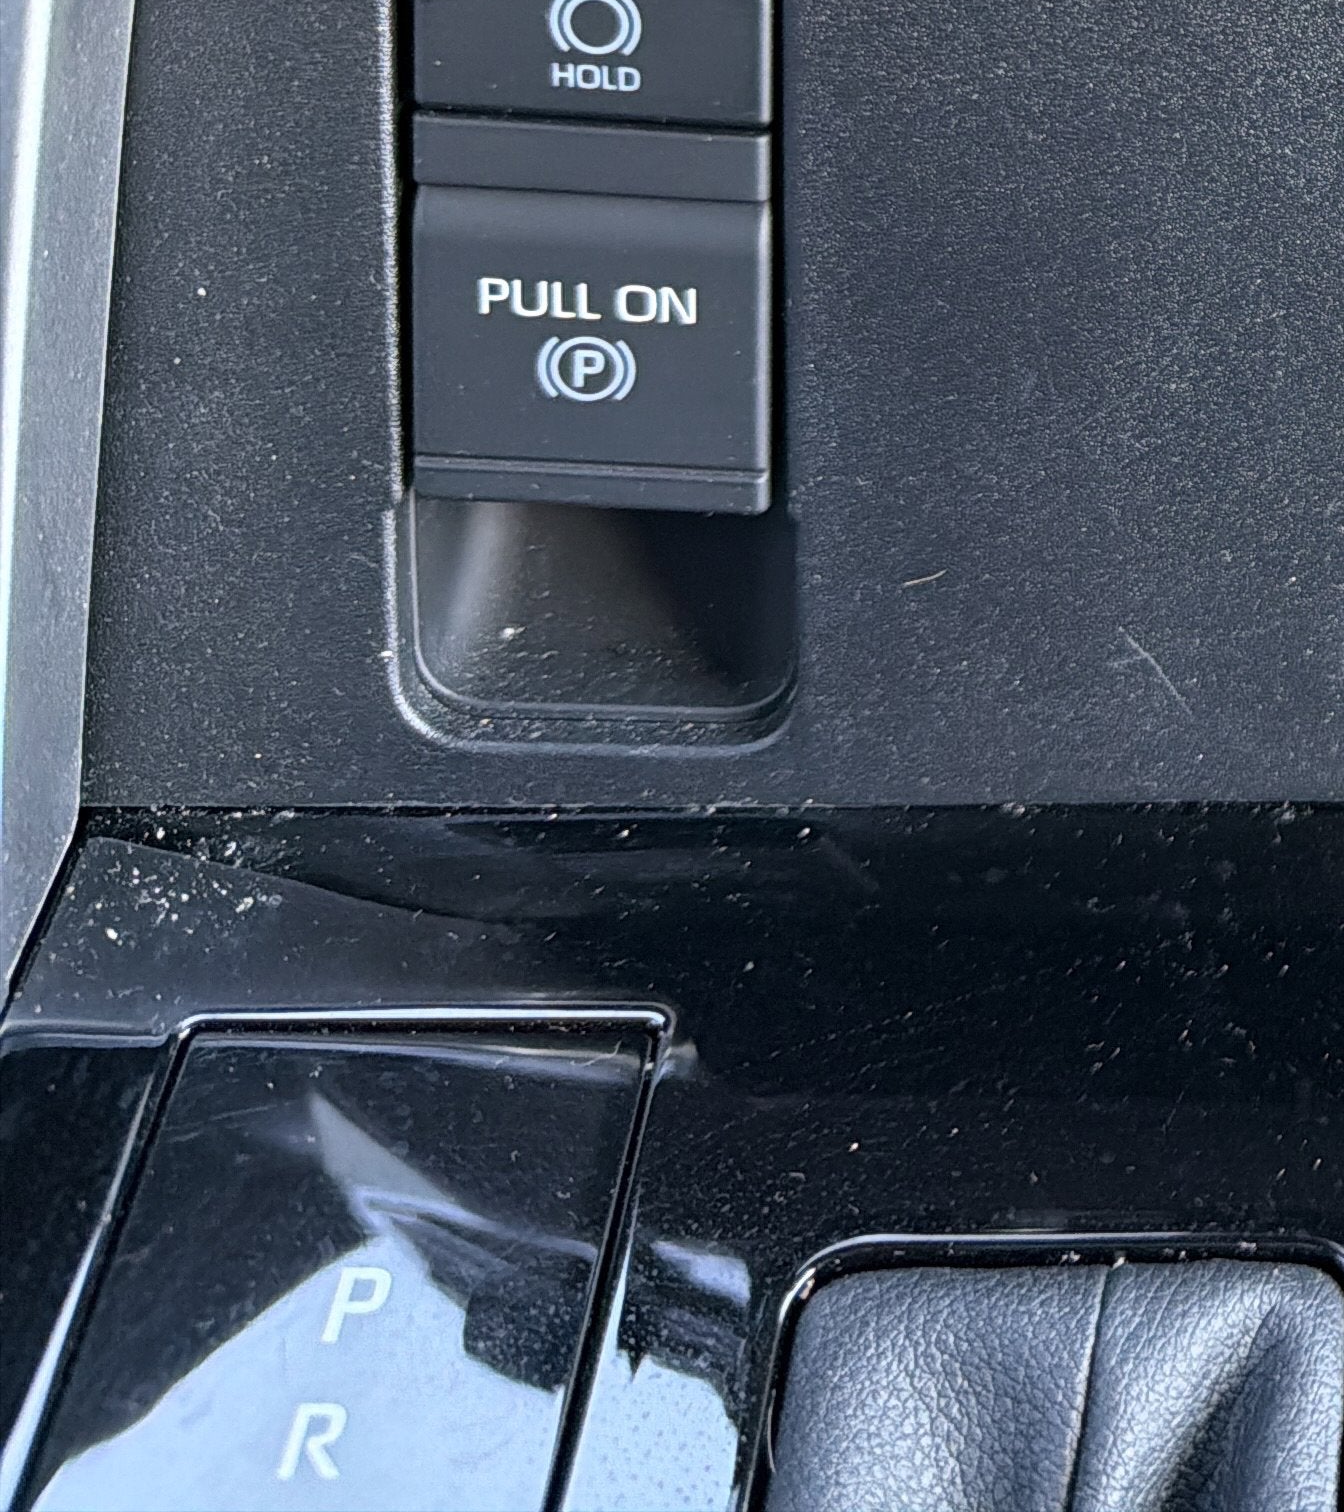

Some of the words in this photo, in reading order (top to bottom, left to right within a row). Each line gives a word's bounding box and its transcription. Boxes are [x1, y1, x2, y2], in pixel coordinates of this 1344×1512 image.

[550, 62, 641, 92] HOLD
[477, 277, 602, 320] PULL
[615, 284, 698, 325] ON
[321, 1266, 392, 1345] P
[276, 1401, 348, 1481] R
